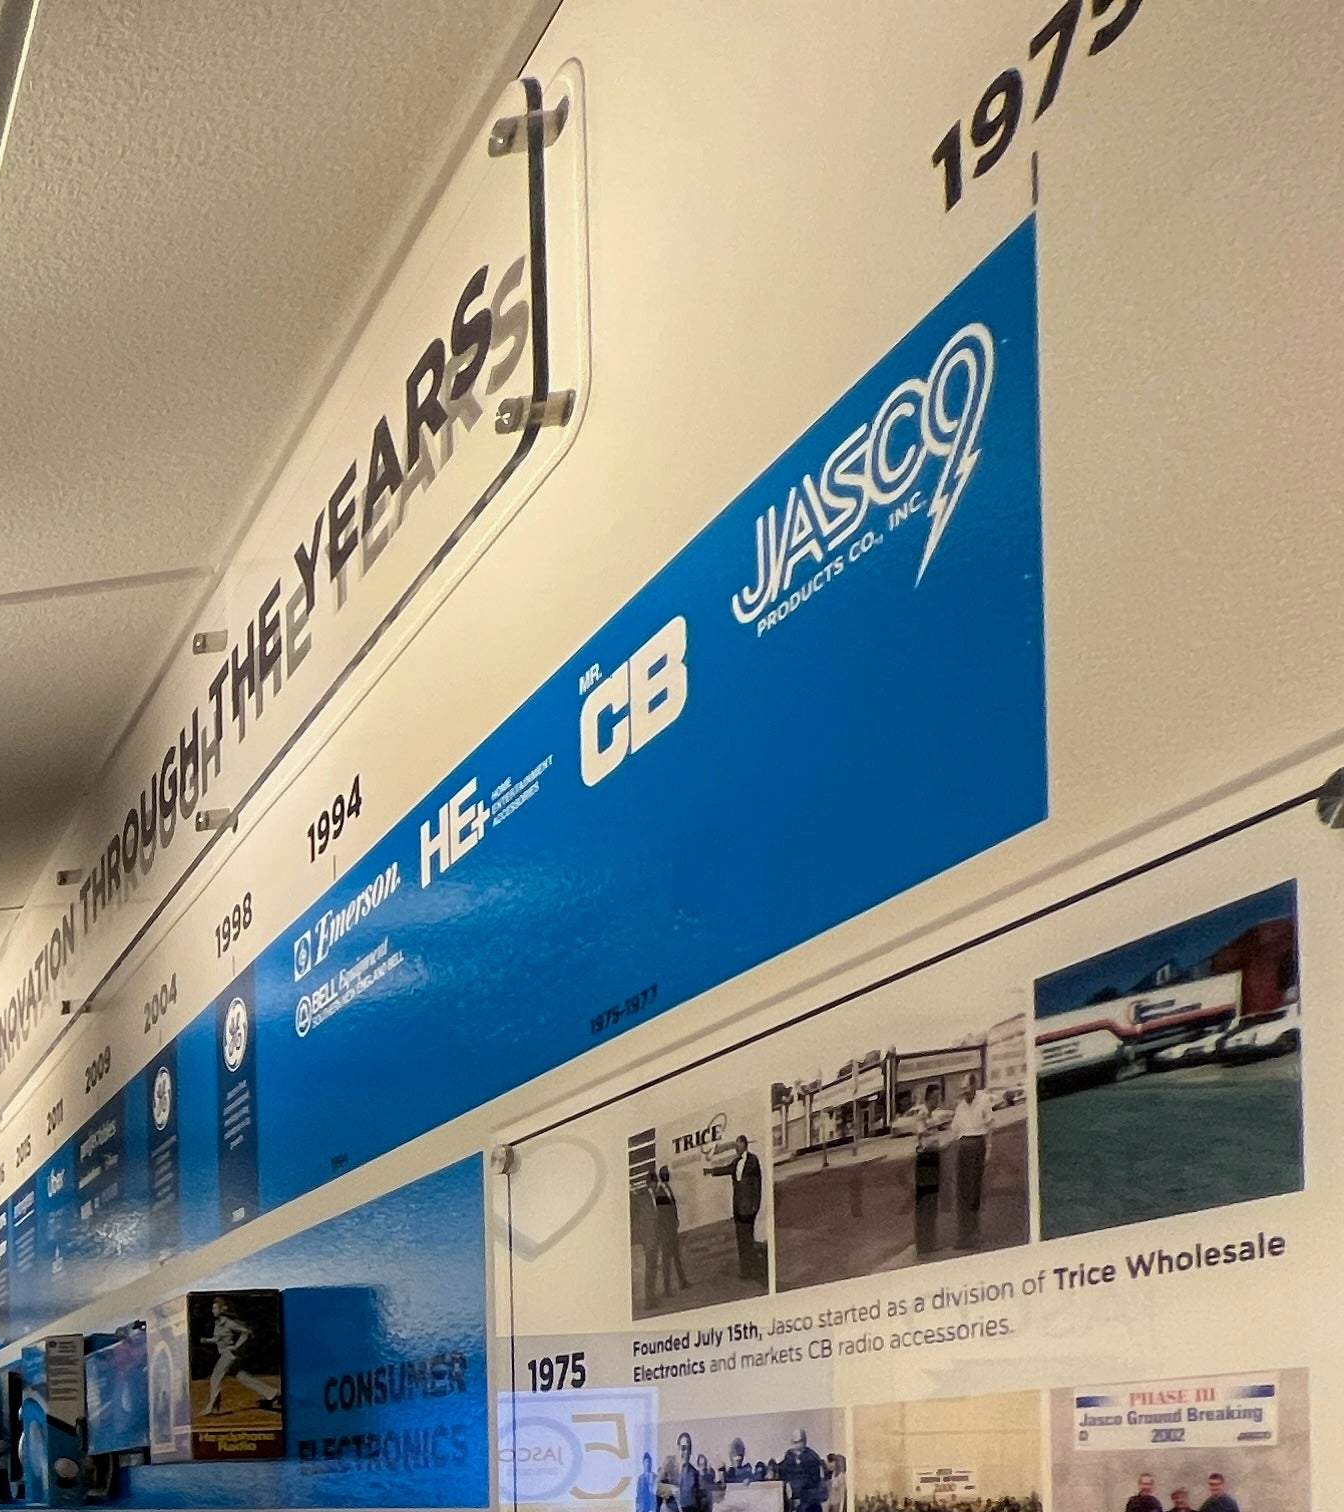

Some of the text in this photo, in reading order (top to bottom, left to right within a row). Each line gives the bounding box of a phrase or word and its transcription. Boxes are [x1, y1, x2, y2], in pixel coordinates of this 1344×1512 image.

[732, 322, 995, 623] JASCO
[757, 556, 844, 637] PRODUCTS
[889, 491, 927, 530] INC.
[78, 707, 199, 936] THROUGH
[209, 577, 282, 743] THE
[294, 264, 492, 614] YEARS
[579, 662, 602, 695] MR.
[580, 615, 688, 787] CB
[307, 774, 362, 863] 1994
[215, 892, 252, 958] 1998
[143, 973, 177, 1034] 2004
[312, 977, 338, 1015] BELL
[590, 983, 658, 1035] 1975-1977
[84, 1045, 111, 1095] 2009
[47, 1098, 64, 1136] 2011
[672, 1124, 724, 1156] TRICE
[633, 1231, 1286, 1357] Founded July 15th, Jasco started division Trice Wholesale
[528, 1352, 586, 1393] 1975
[633, 1316, 1016, 1383] Electronics and markets CB radio accessories.
[324, 1352, 468, 1414] CONSUMER
[1129, 1389, 1187, 1406] PHASE
[1079, 1405, 1263, 1427] Jasco Ground Breaking
[299, 1424, 467, 1474] ELECTRONICS
